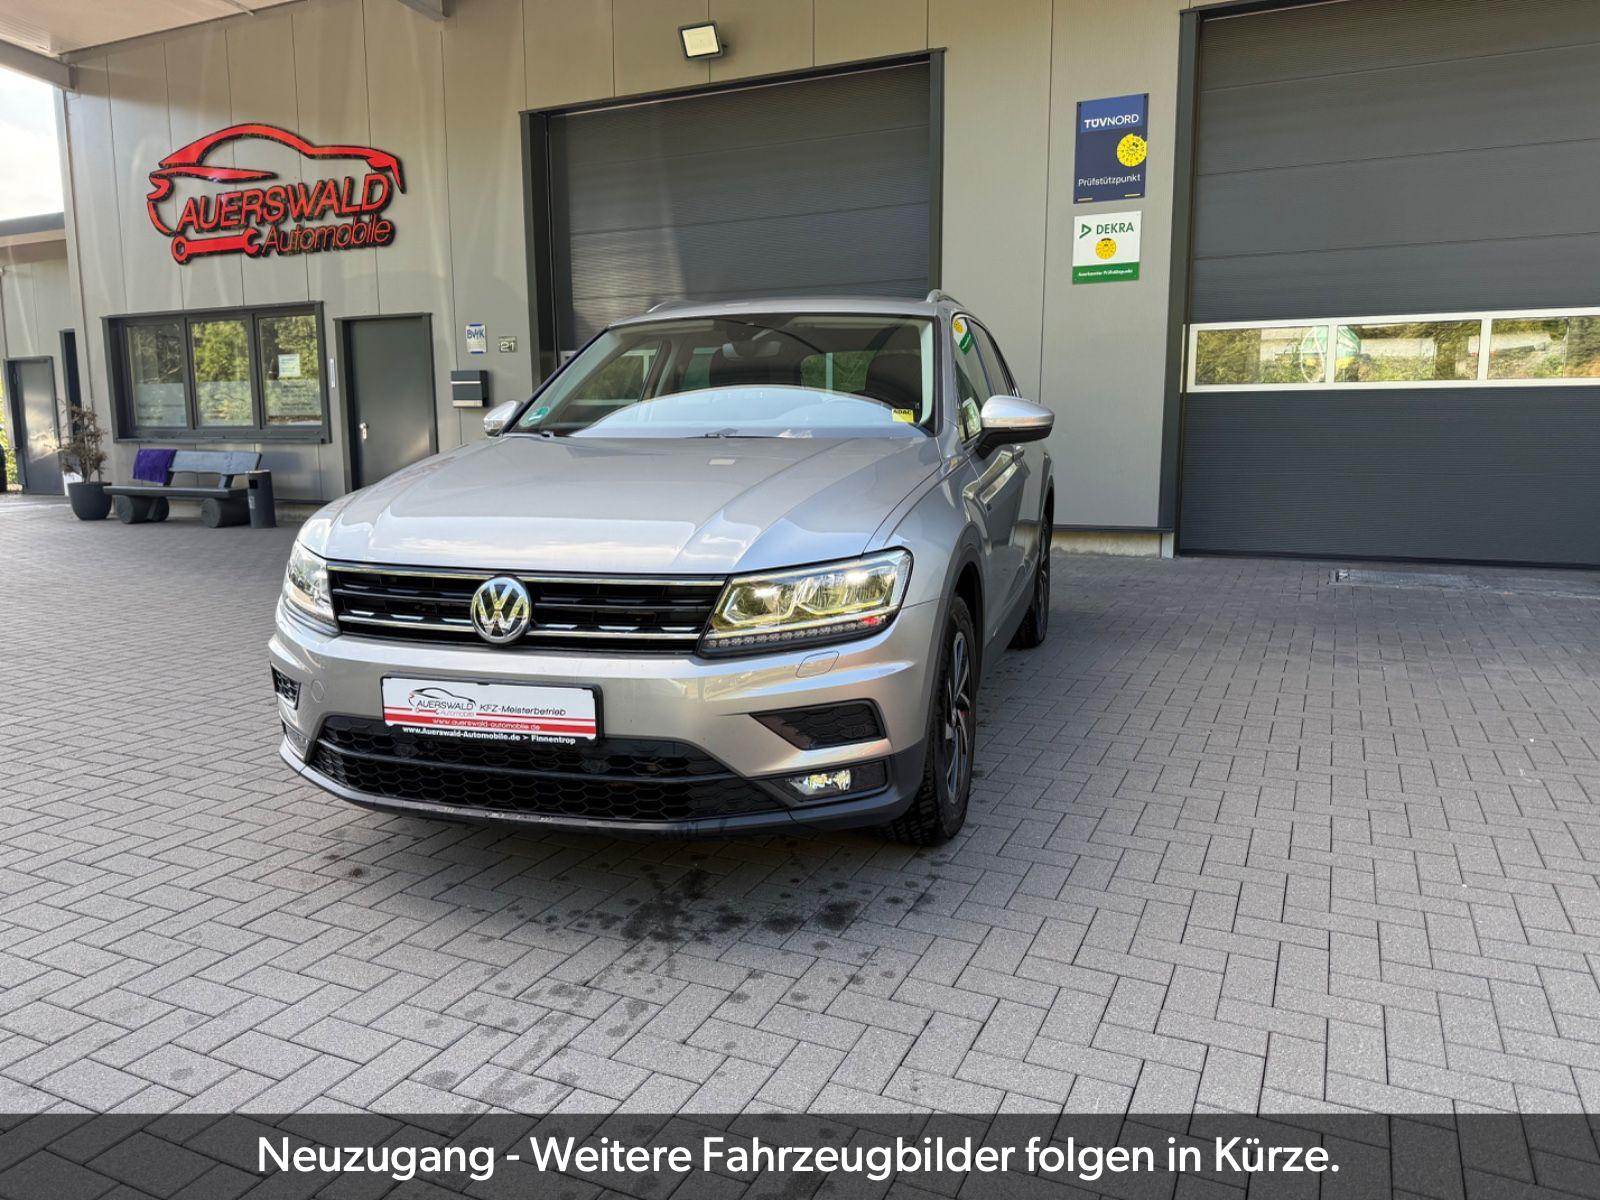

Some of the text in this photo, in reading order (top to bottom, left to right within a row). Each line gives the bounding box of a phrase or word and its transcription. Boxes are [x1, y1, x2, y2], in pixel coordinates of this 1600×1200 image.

[1078, 173, 1141, 188] Prüfstützpunkt
[177, 173, 391, 234] AUERSWALD
[261, 214, 393, 257] Automobile
[1096, 221, 1135, 236] DEKRA
[416, 700, 474, 711] AUERSWALD
[480, 703, 566, 717] KFZ-Meisterbetrieb
[402, 726, 576, 745] www.Auerswald-Automobile.de Finnentrop
